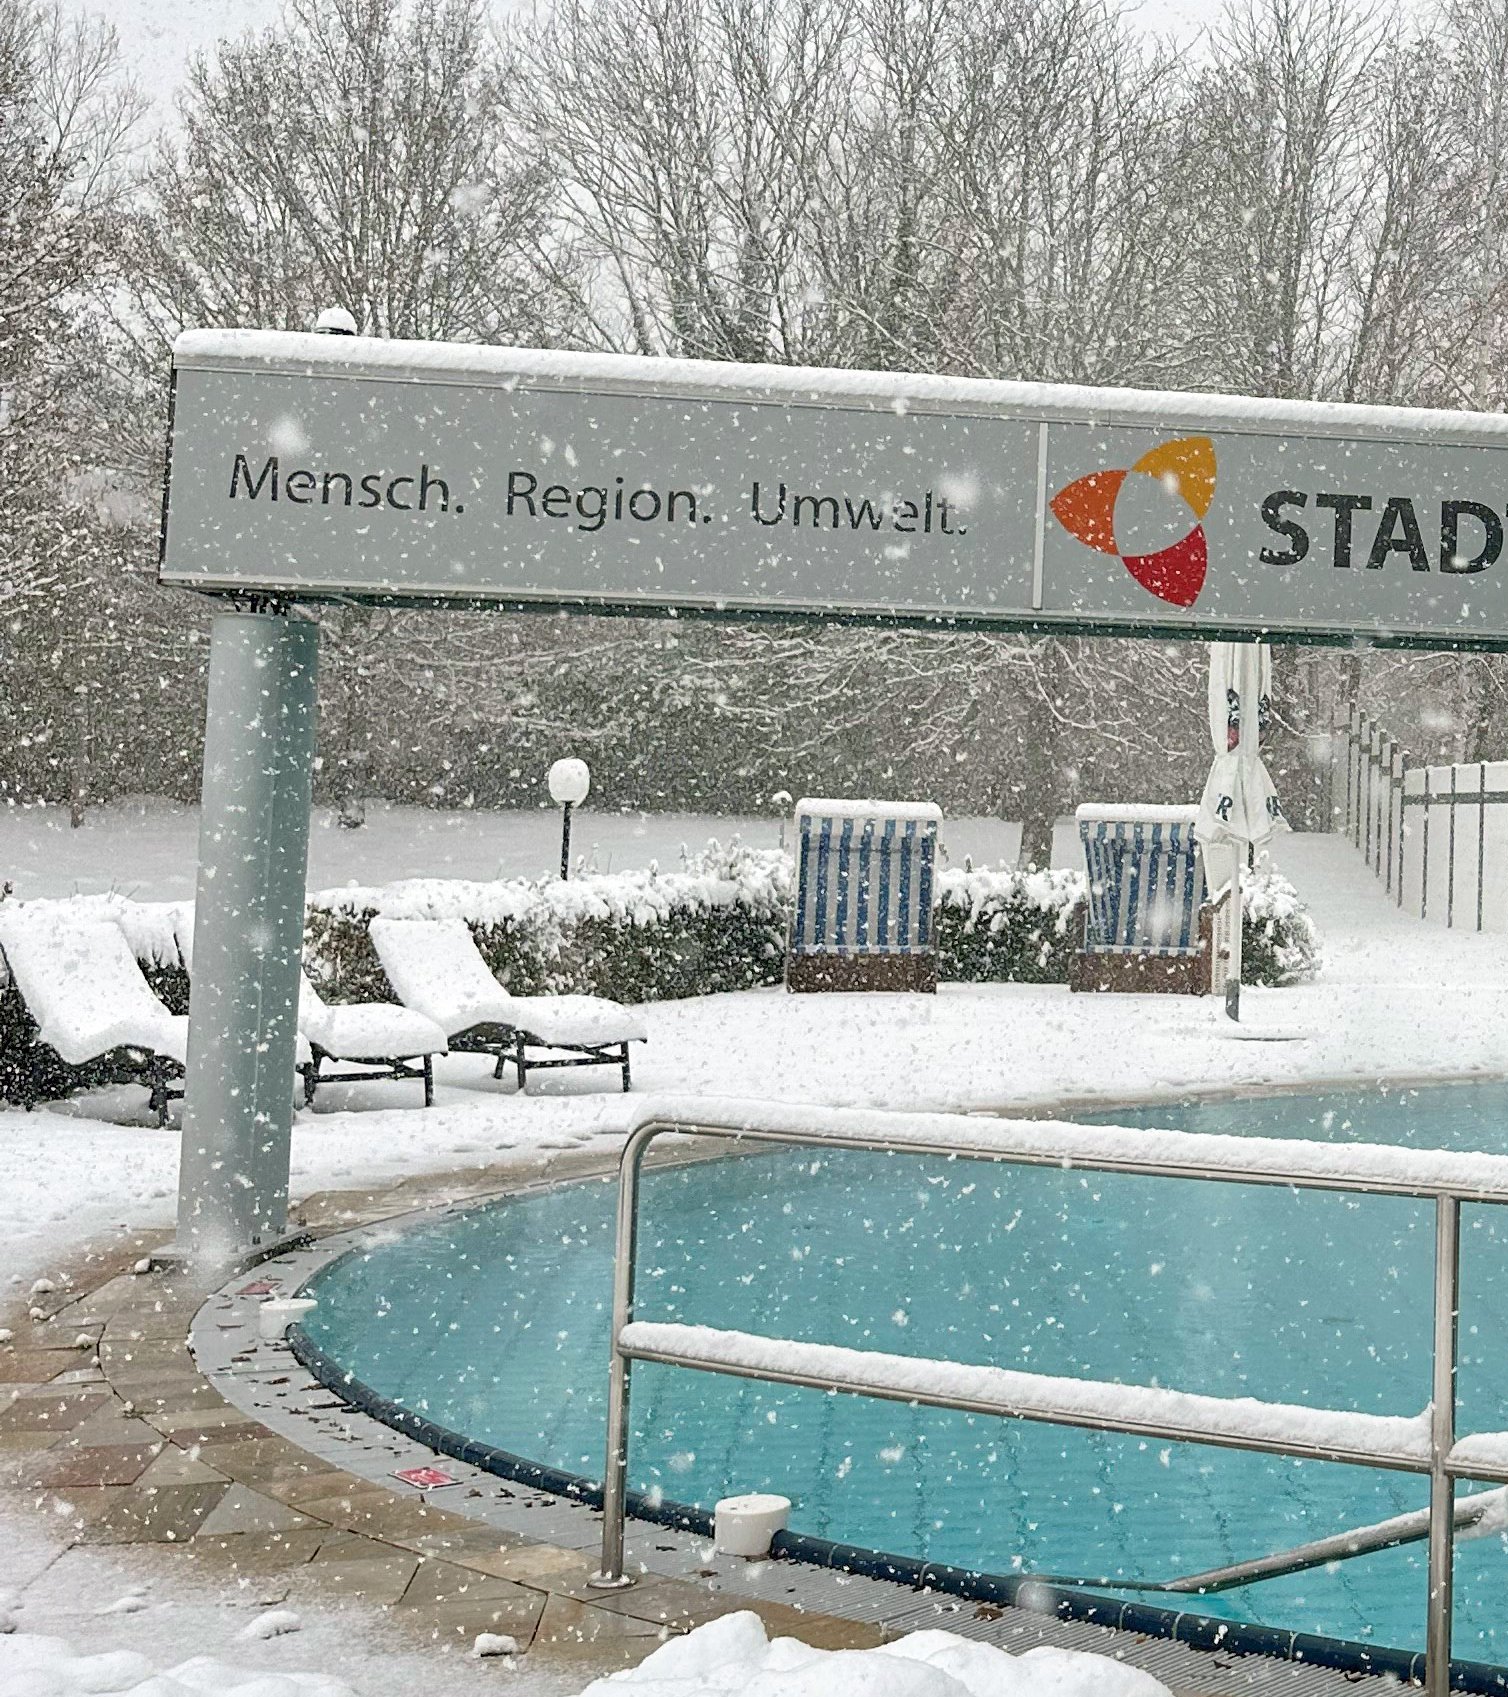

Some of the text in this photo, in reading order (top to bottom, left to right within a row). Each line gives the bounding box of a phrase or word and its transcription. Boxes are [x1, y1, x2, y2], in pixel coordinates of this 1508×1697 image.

[229, 453, 967, 536] Mensch. Region. Umwelt.
